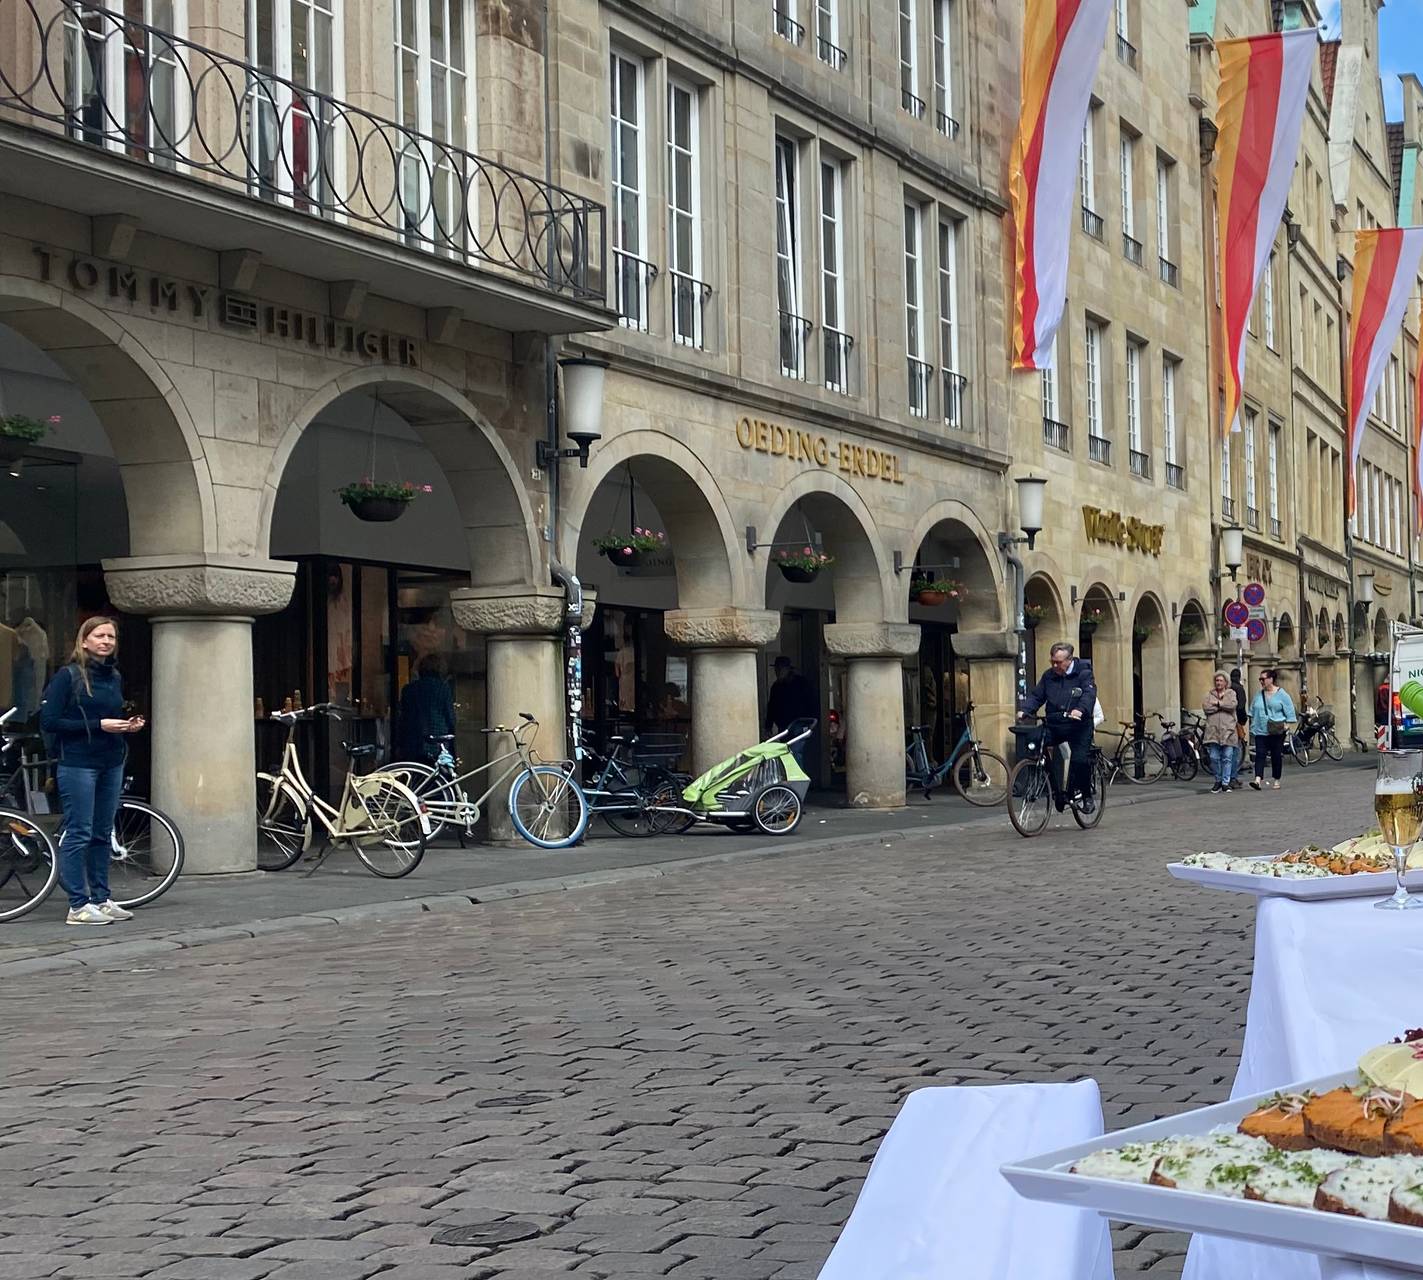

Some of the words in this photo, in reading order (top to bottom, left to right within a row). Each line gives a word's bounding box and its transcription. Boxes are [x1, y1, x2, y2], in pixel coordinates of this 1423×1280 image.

[31, 246, 212, 318] TOMMY
[265, 306, 419, 367] HILFIGER
[736, 415, 904, 485] OEDING-ERDEL
